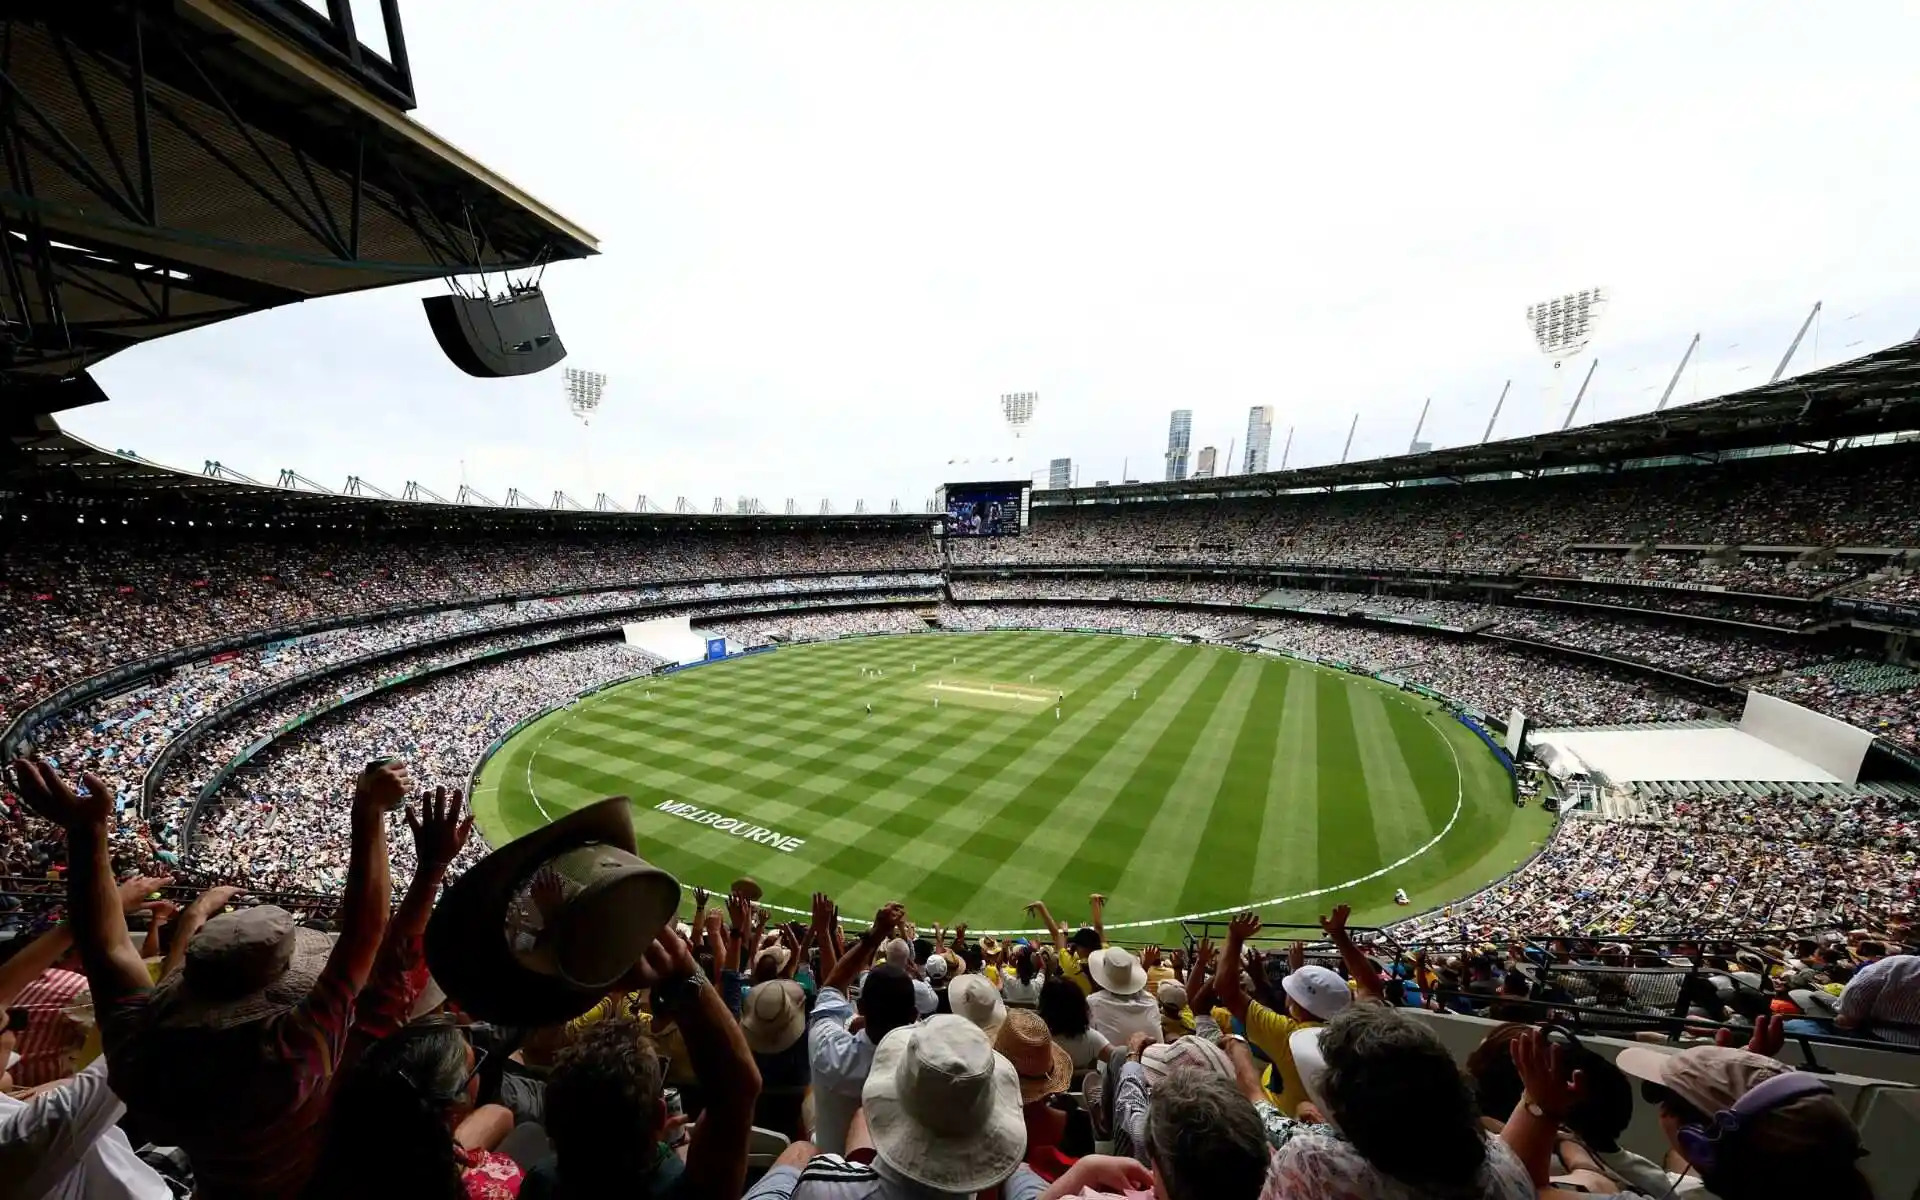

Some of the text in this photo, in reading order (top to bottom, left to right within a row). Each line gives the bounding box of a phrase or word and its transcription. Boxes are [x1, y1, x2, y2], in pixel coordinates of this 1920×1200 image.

[1648, 580, 1678, 589] CRICKET
[1681, 583, 1701, 591] CLUB
[654, 800, 806, 852] MELBOURNE
